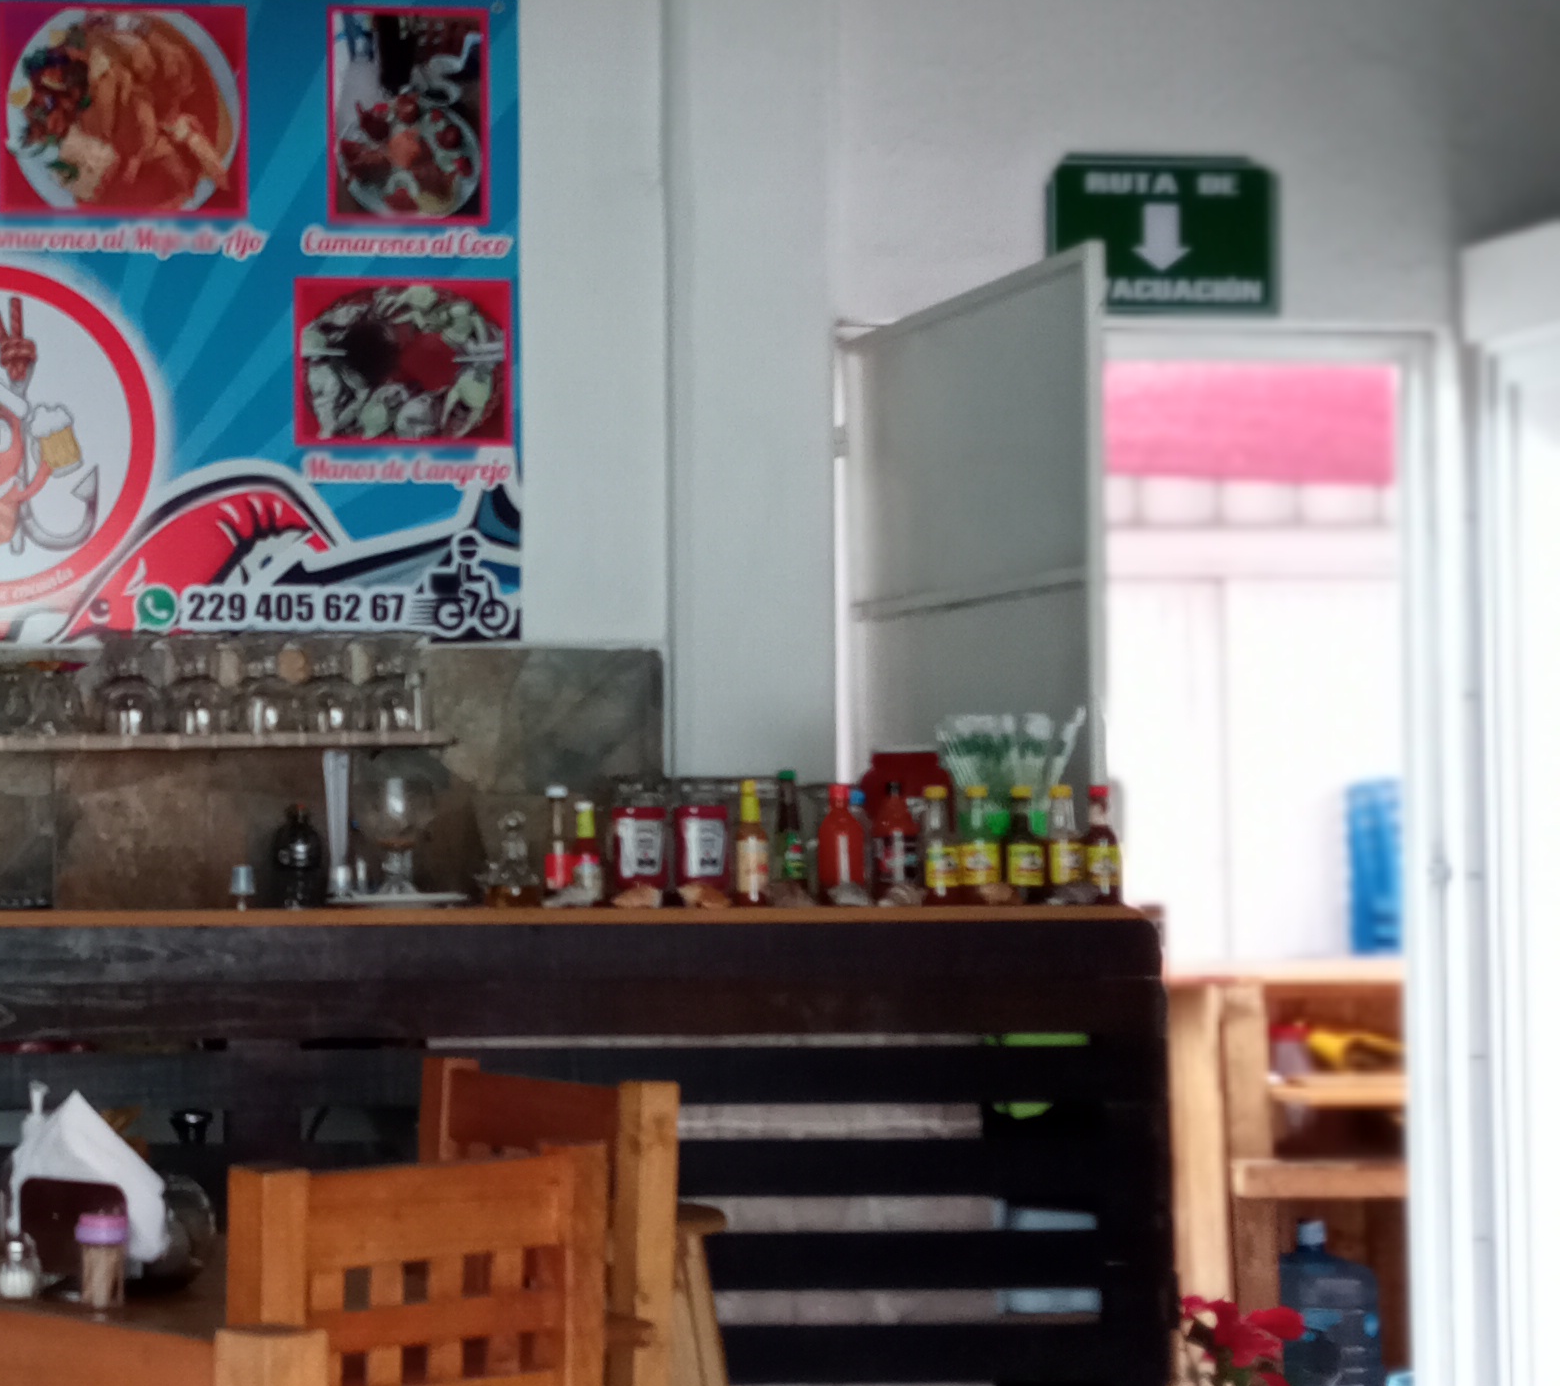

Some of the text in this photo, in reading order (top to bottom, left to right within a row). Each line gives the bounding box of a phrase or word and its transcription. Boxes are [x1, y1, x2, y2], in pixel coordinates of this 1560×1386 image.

[1083, 171, 1180, 196] RUTA
[303, 231, 510, 255] Camarones al Coco
[1108, 275, 1263, 303] ACUACIÓN
[308, 457, 510, 487] Manos de Cangrejo
[188, 592, 406, 623] 229 405 62 67
